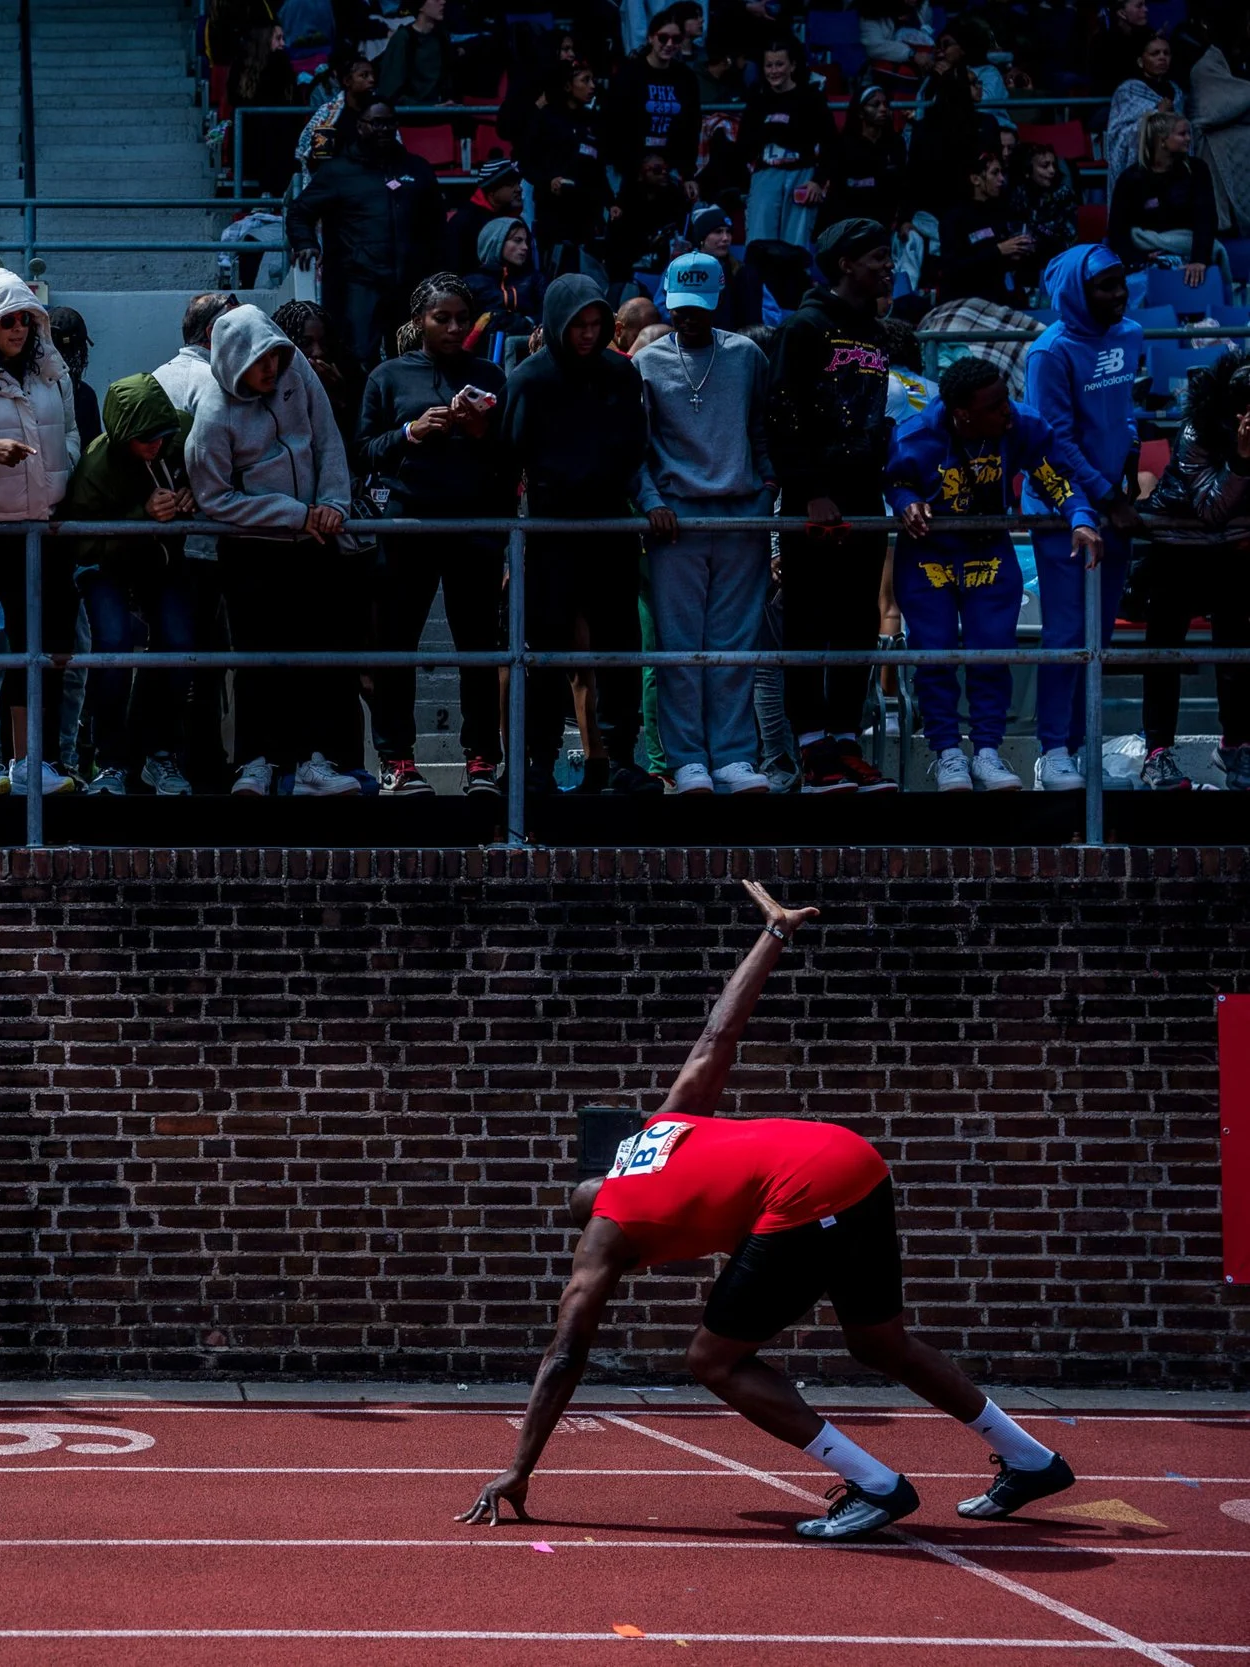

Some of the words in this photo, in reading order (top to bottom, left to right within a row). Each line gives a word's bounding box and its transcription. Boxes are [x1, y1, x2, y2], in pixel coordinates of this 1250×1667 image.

[677, 270, 709, 283] LOTTO
[1083, 381, 1103, 392] new
[1103, 372, 1135, 388] balance
[437, 709, 449, 730] 2
[630, 1147, 657, 1168] B
[646, 1125, 676, 1139] C
